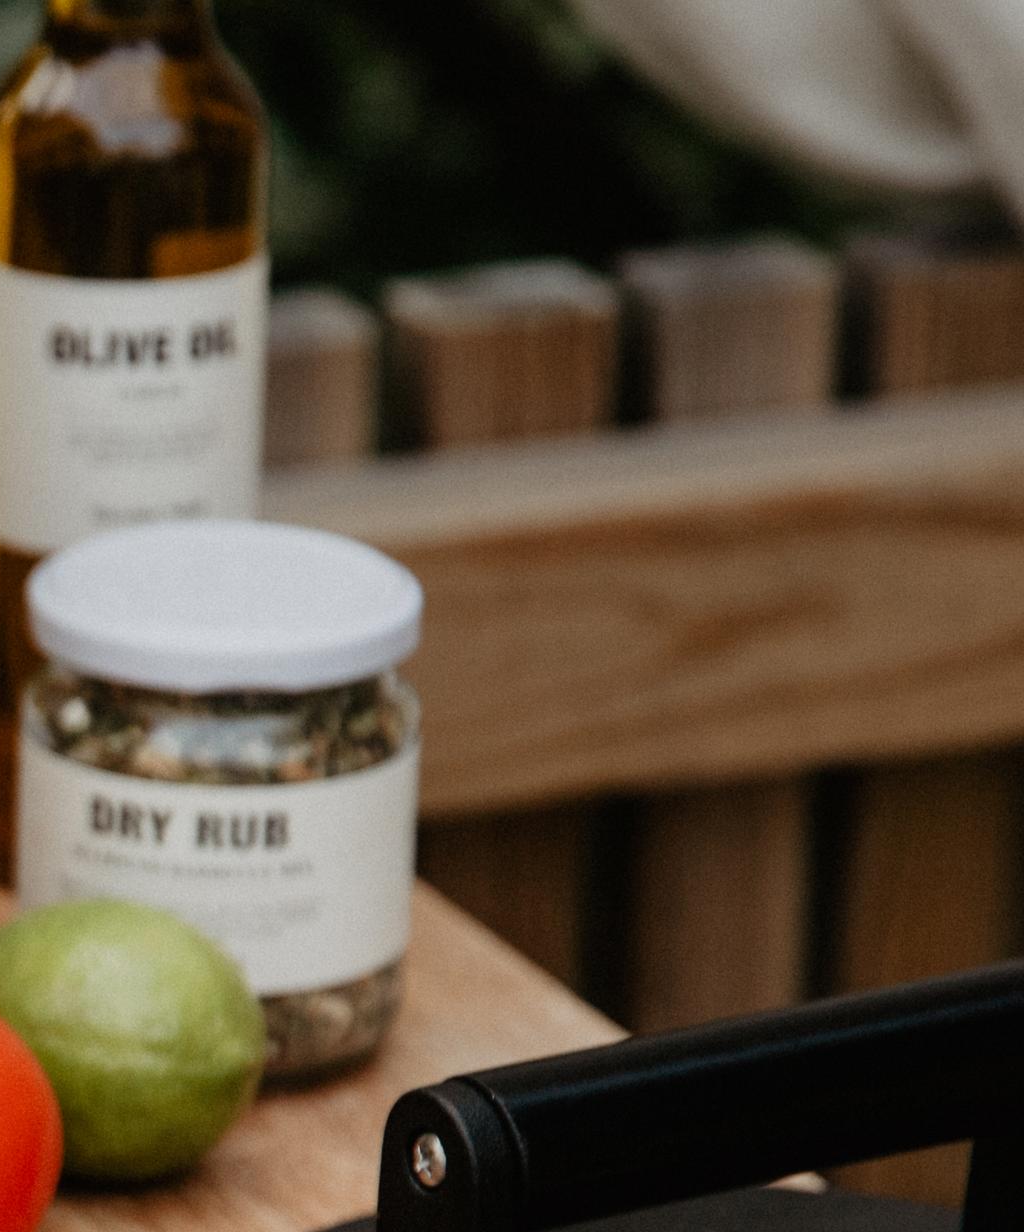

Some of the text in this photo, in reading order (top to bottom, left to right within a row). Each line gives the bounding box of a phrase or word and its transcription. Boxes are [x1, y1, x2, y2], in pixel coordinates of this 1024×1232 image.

[48, 324, 169, 367] OLIVE
[90, 795, 289, 848] DRY RUB
